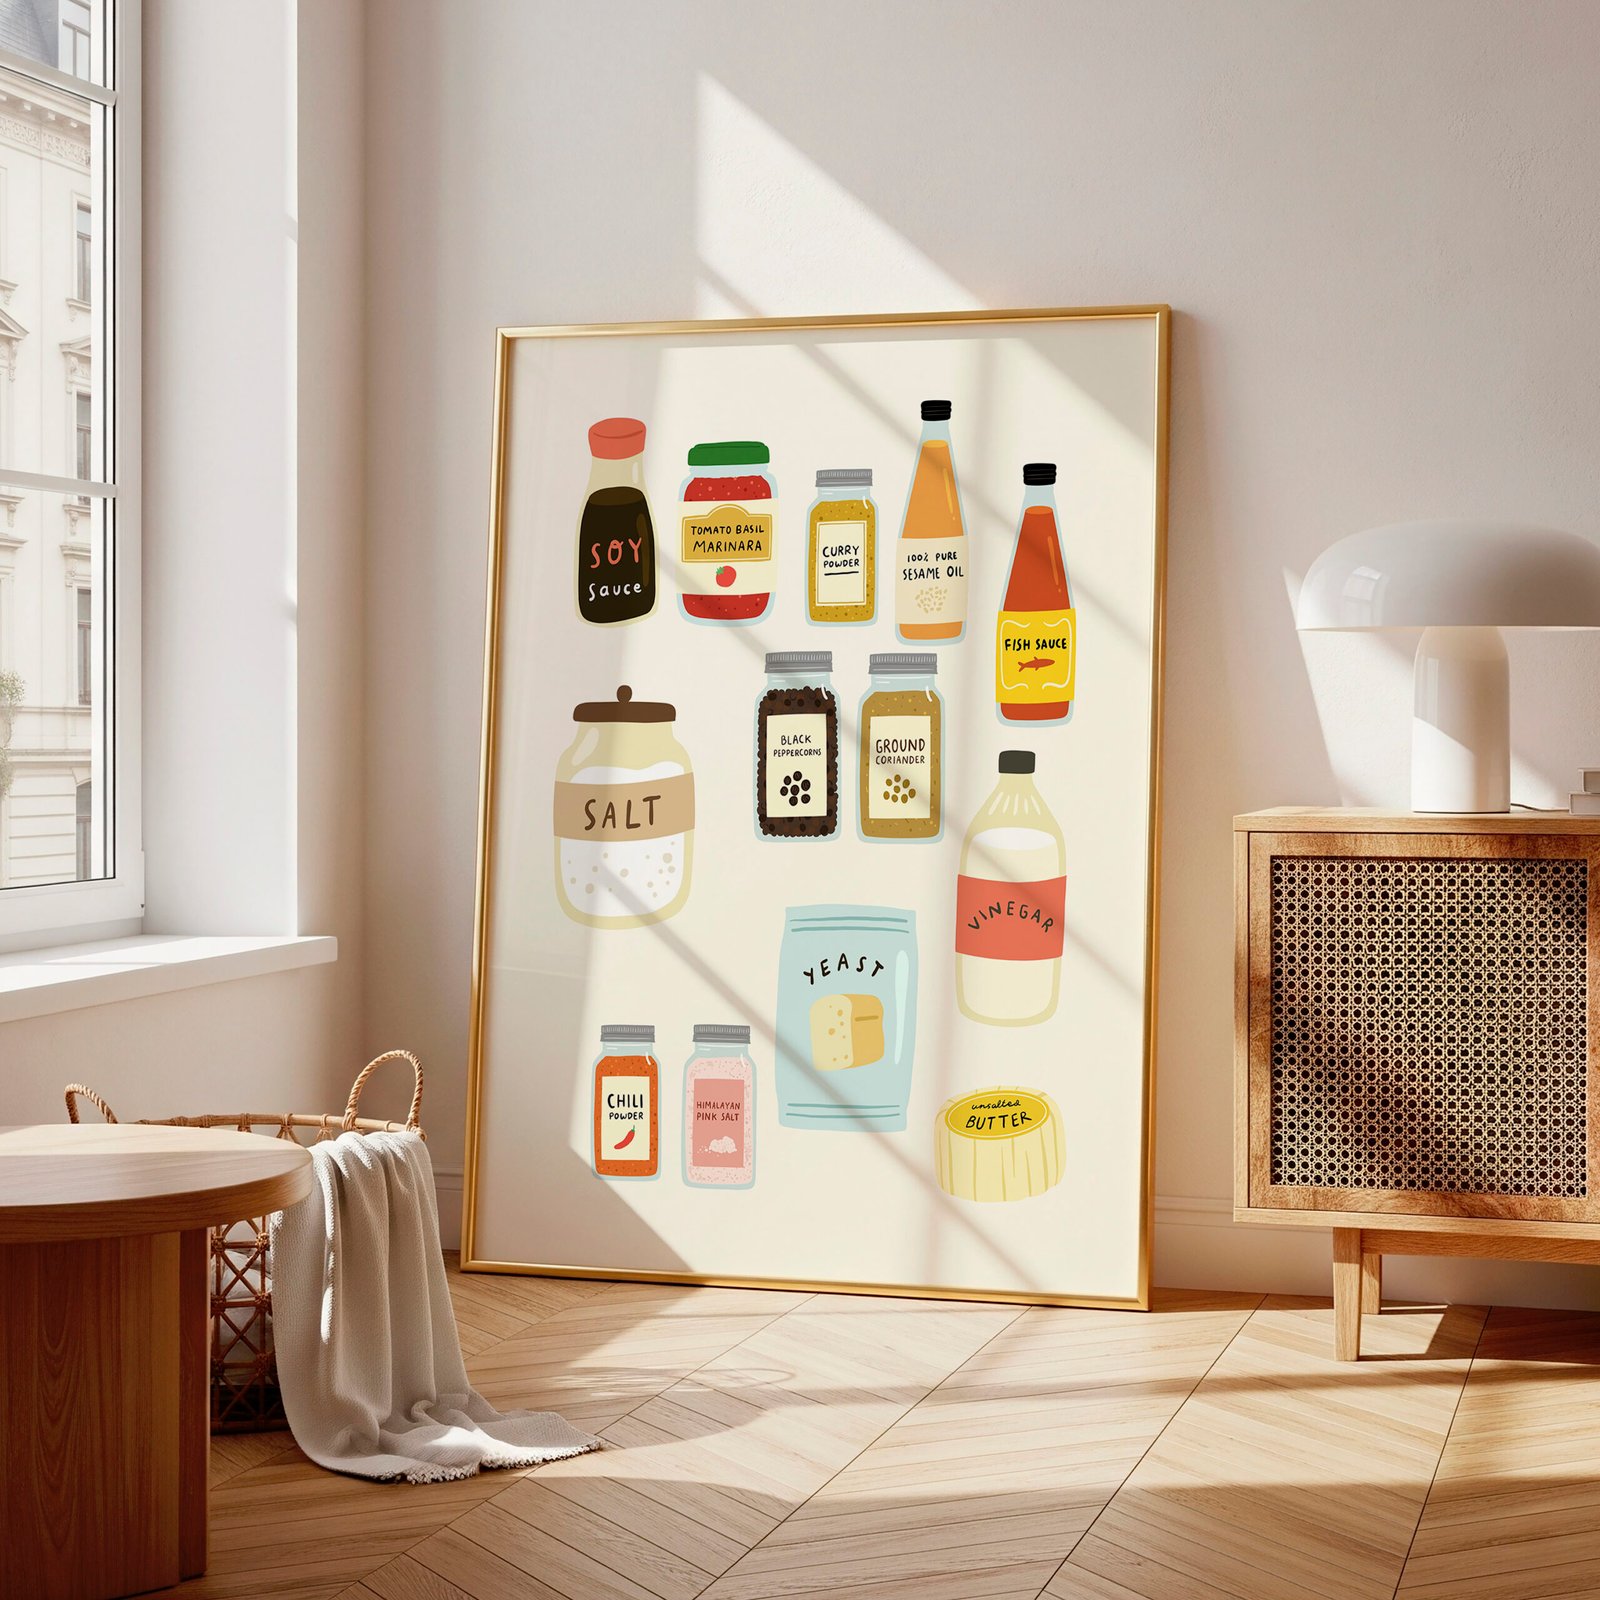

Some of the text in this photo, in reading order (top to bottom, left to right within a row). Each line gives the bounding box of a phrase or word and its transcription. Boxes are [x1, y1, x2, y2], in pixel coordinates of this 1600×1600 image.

[690, 524, 765, 535] TOMATO BASIL
[590, 537, 642, 569] SOY
[693, 539, 762, 553] MARINARA
[822, 544, 860, 558] CURRY
[823, 558, 860, 568] POWDER
[907, 551, 958, 563] 100% PURE
[902, 565, 964, 581] SESAME OIL
[1004, 637, 1067, 652] FISH SAUCE
[780, 734, 812, 746] BLACK
[875, 738, 926, 754] GROUND
[773, 748, 822, 757] PEPPERCORNS
[875, 755, 925, 765] CORIANDER
[584, 795, 661, 831] SALT
[968, 901, 1054, 932] VINEGAR
[803, 952, 885, 985] YEAST
[607, 1093, 644, 1109] CHILI
[696, 1101, 741, 1110] HIMALAYAN
[971, 1099, 1021, 1110] unsalted
[609, 1111, 644, 1121] POWDER
[696, 1112, 740, 1121] PINK SALT
[965, 1111, 1032, 1130] BUTTER
